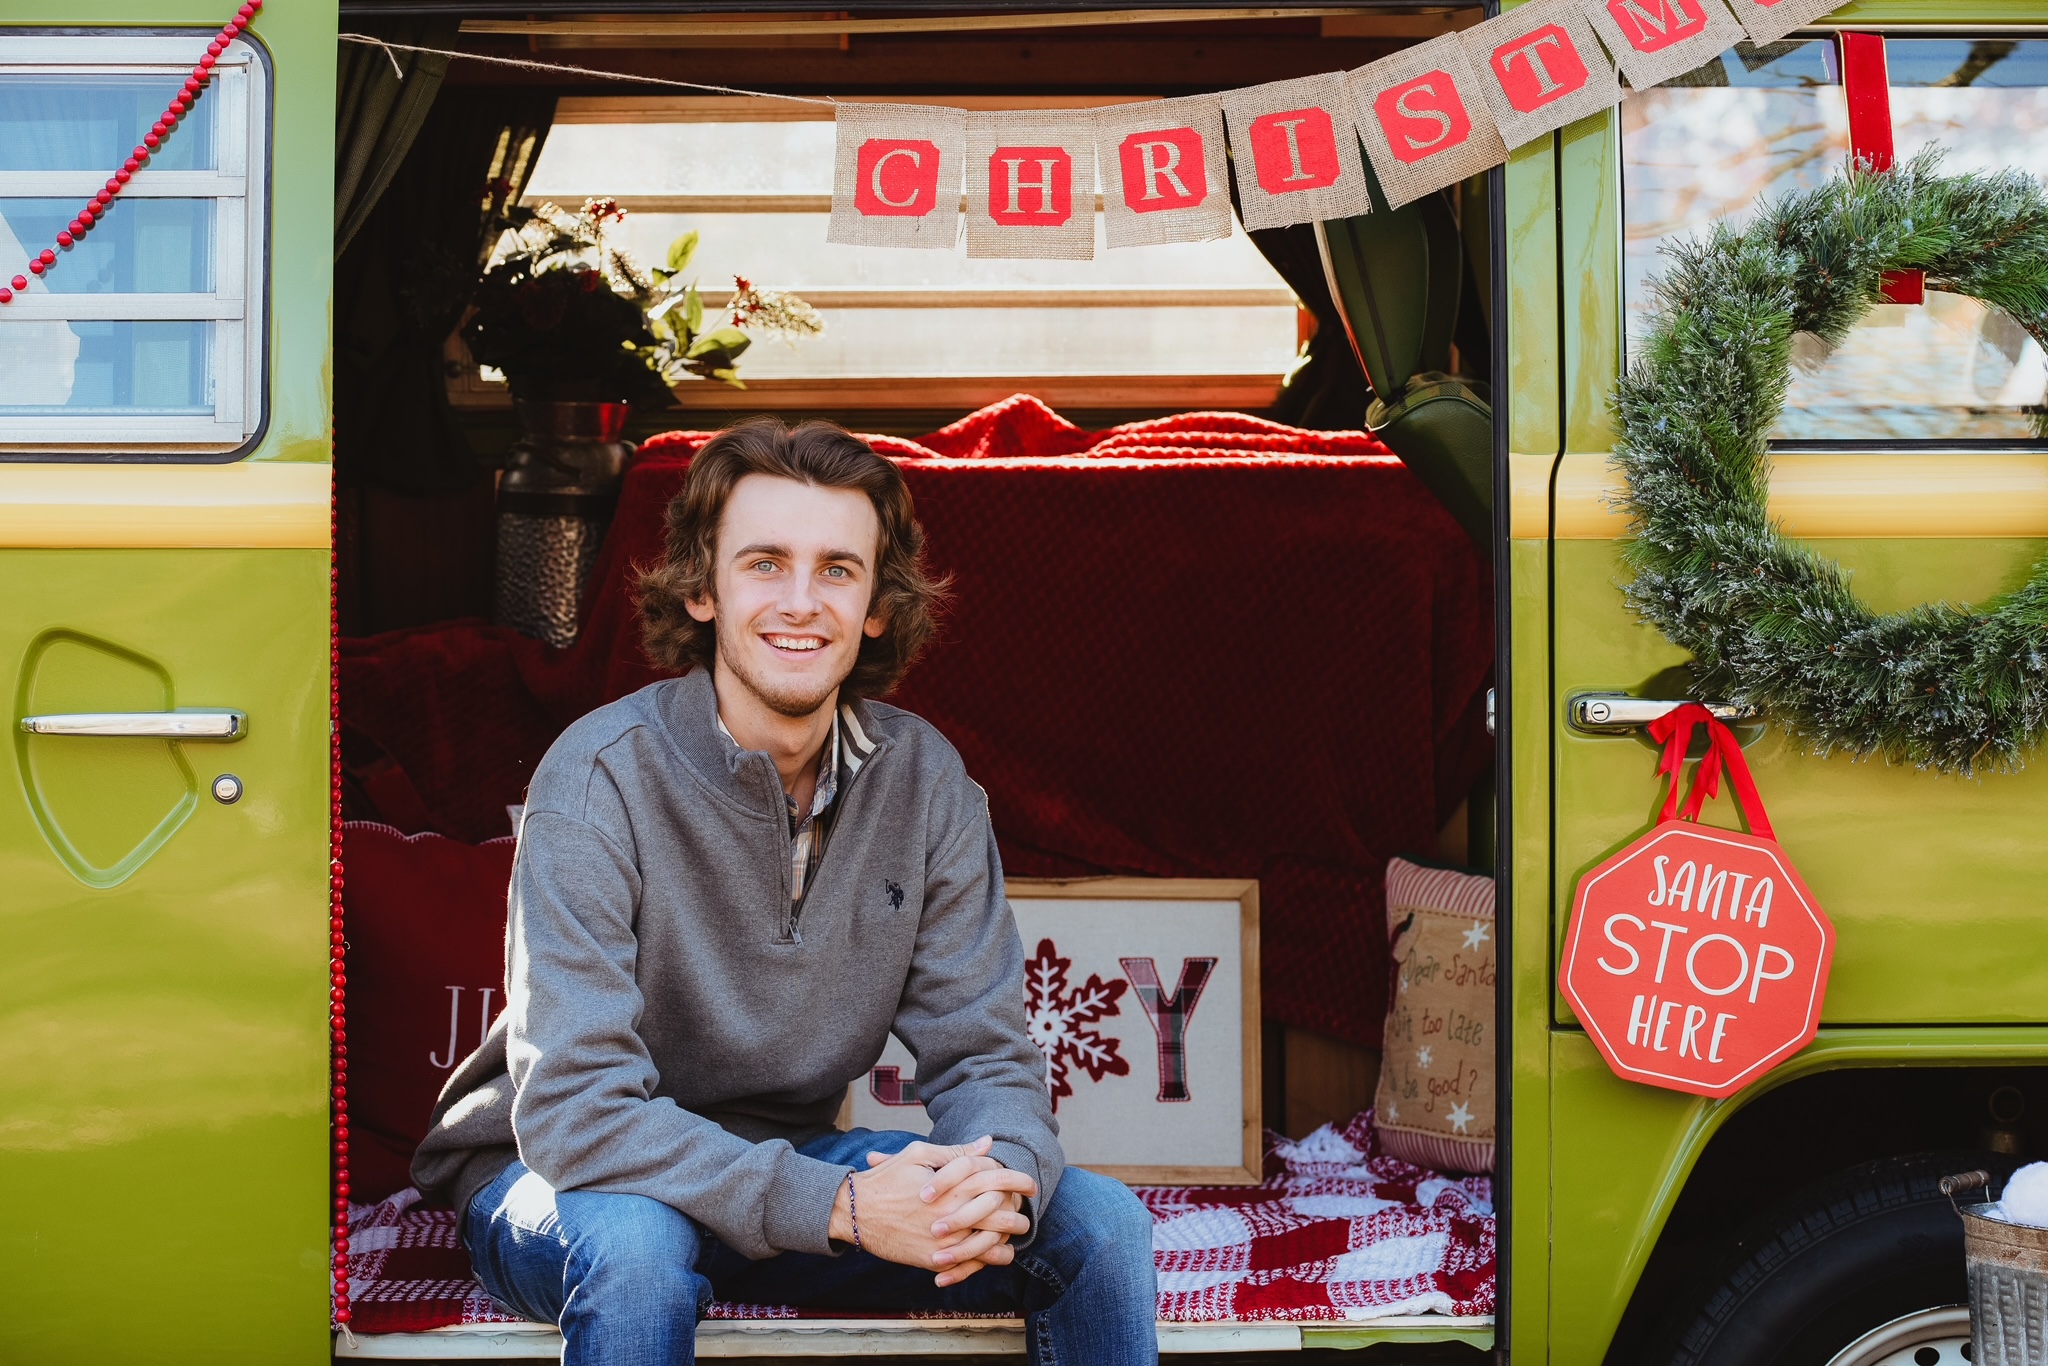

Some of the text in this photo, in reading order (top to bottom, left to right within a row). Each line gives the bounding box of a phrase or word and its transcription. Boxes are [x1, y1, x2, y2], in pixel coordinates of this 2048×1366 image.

[1647, 855, 1774, 928] SANTA
[1406, 948, 1440, 987] Dear
[1596, 913, 1795, 1004] STOP
[1422, 1008, 1443, 1036] too
[1447, 1009, 1484, 1046] late
[1626, 994, 1738, 1064] HERE
